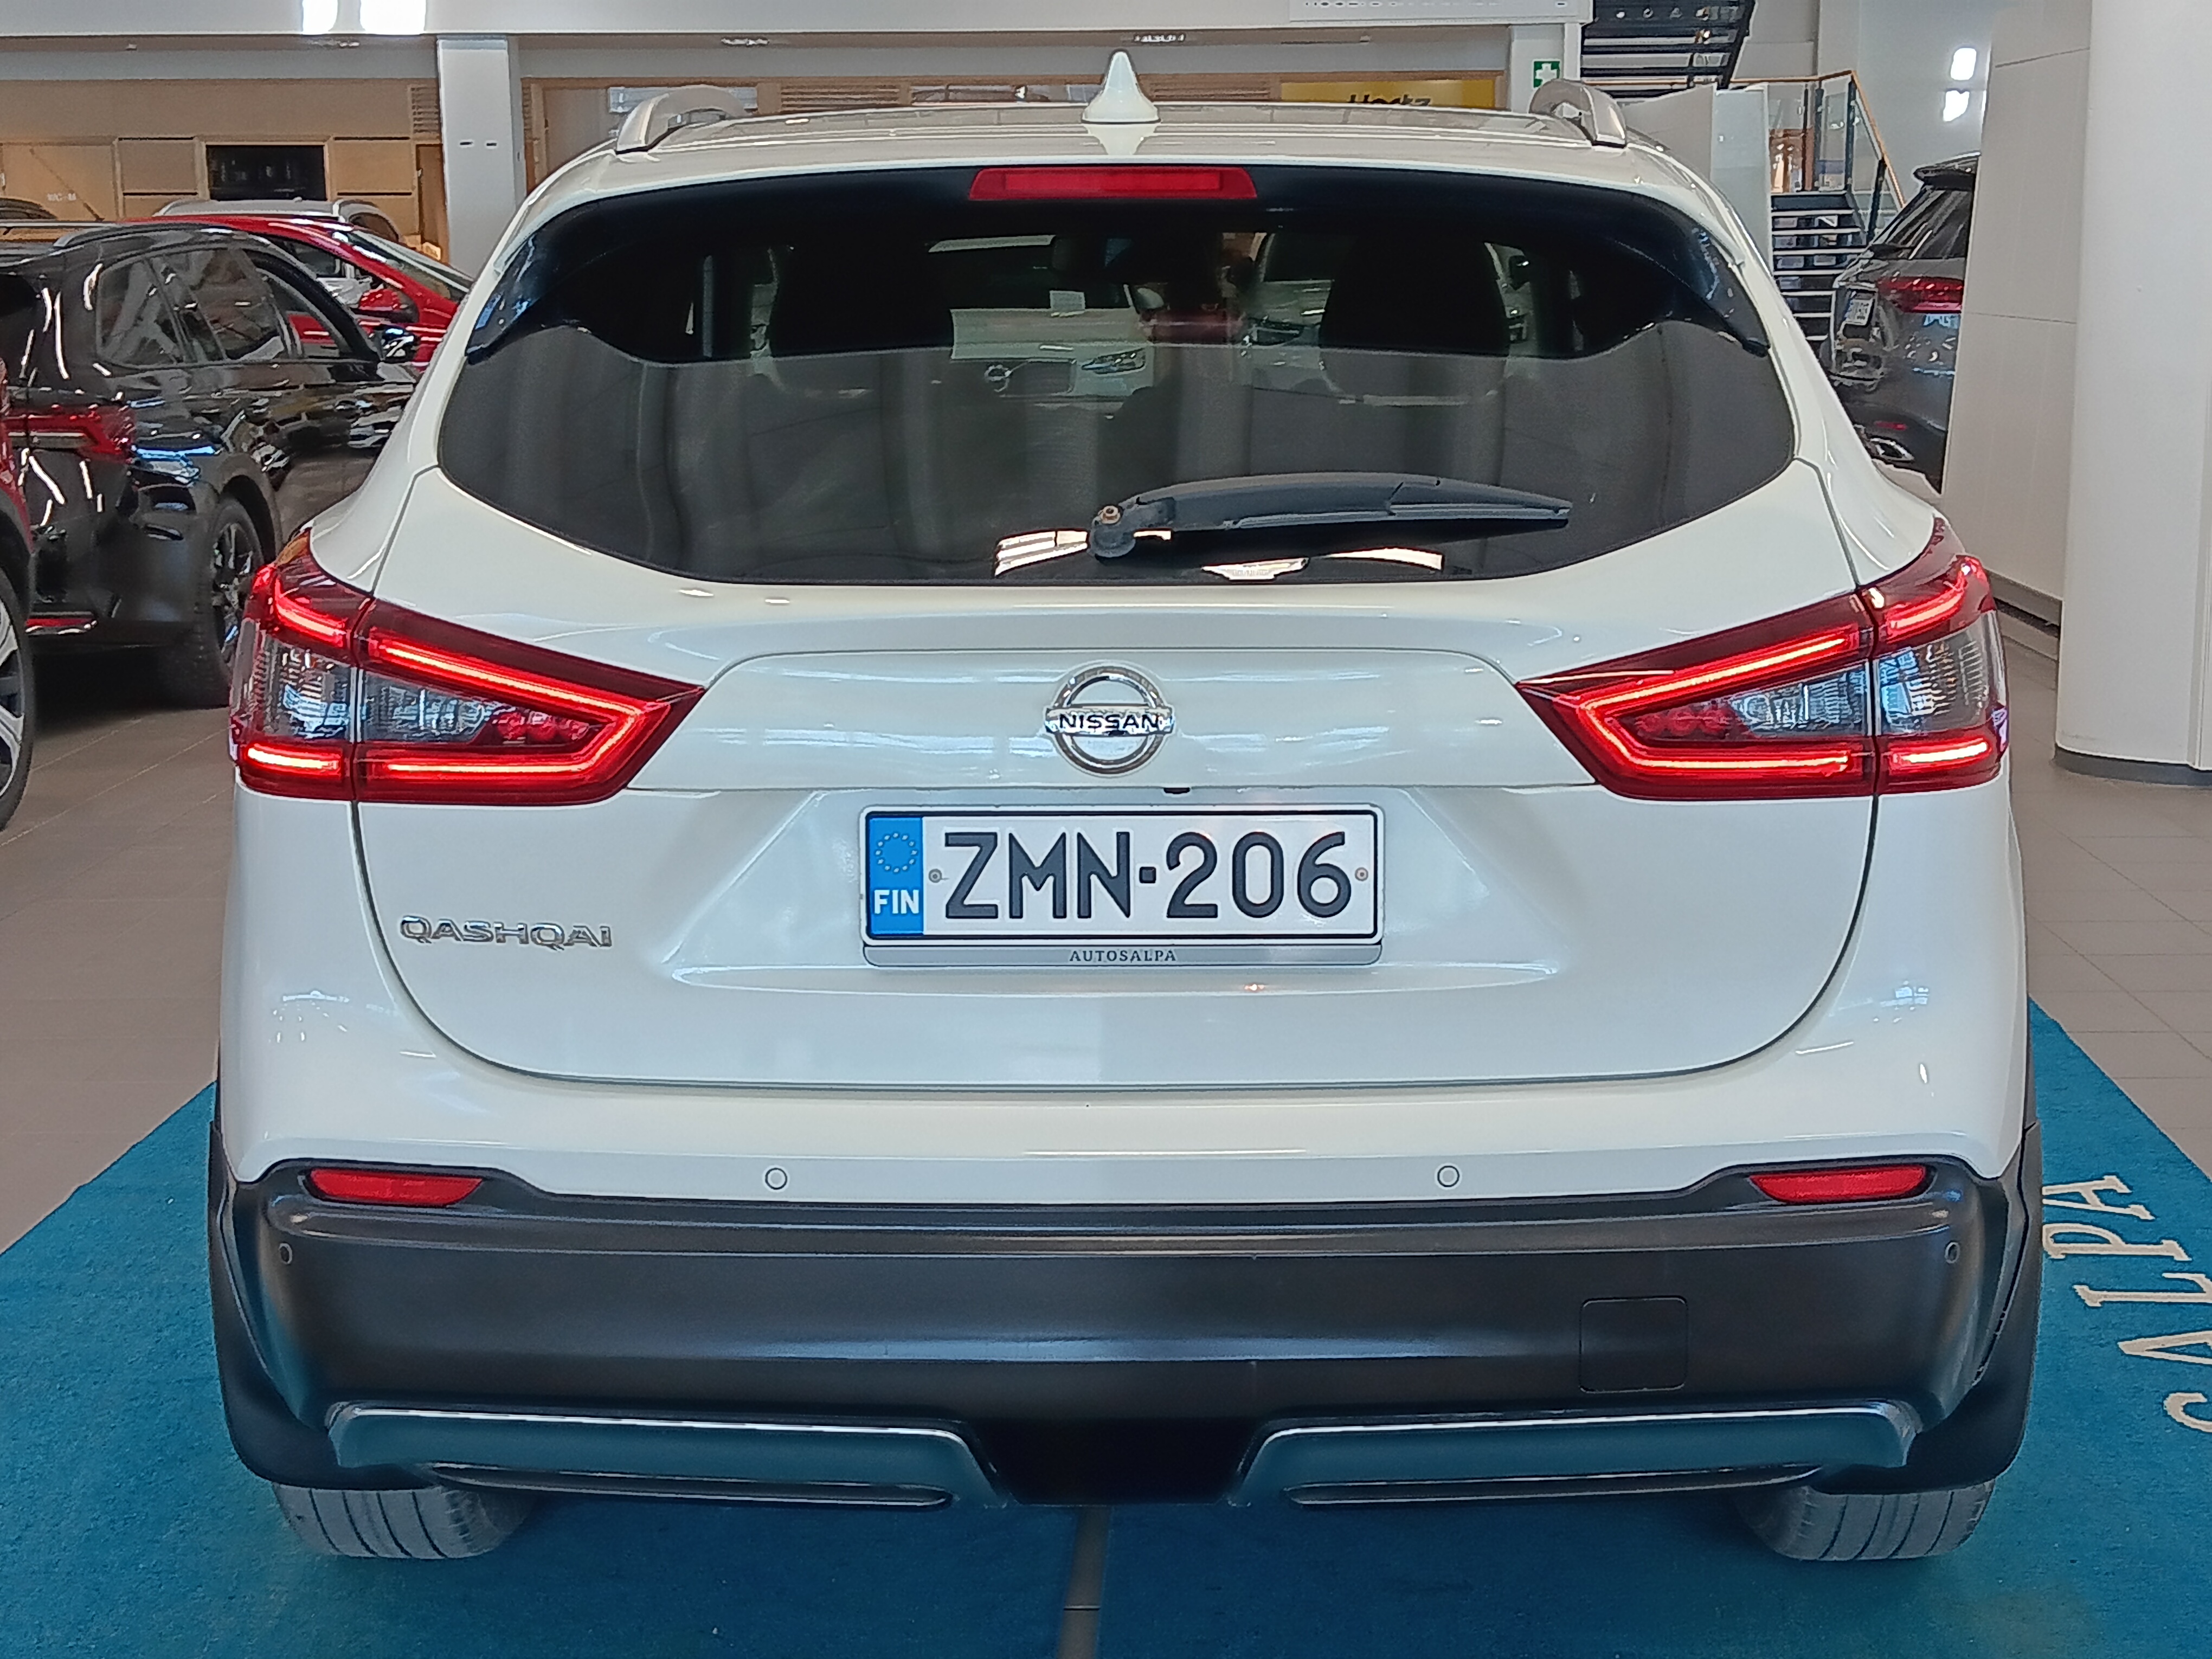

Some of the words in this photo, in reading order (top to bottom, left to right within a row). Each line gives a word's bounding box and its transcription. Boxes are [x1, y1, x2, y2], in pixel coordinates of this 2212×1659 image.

[1059, 713, 1160, 730] NISSAN
[944, 831, 1352, 919] ZMN-206
[874, 889, 919, 914] FIN
[400, 915, 613, 951] QASHQAI
[1070, 950, 1176, 962] AUTOSALPA
